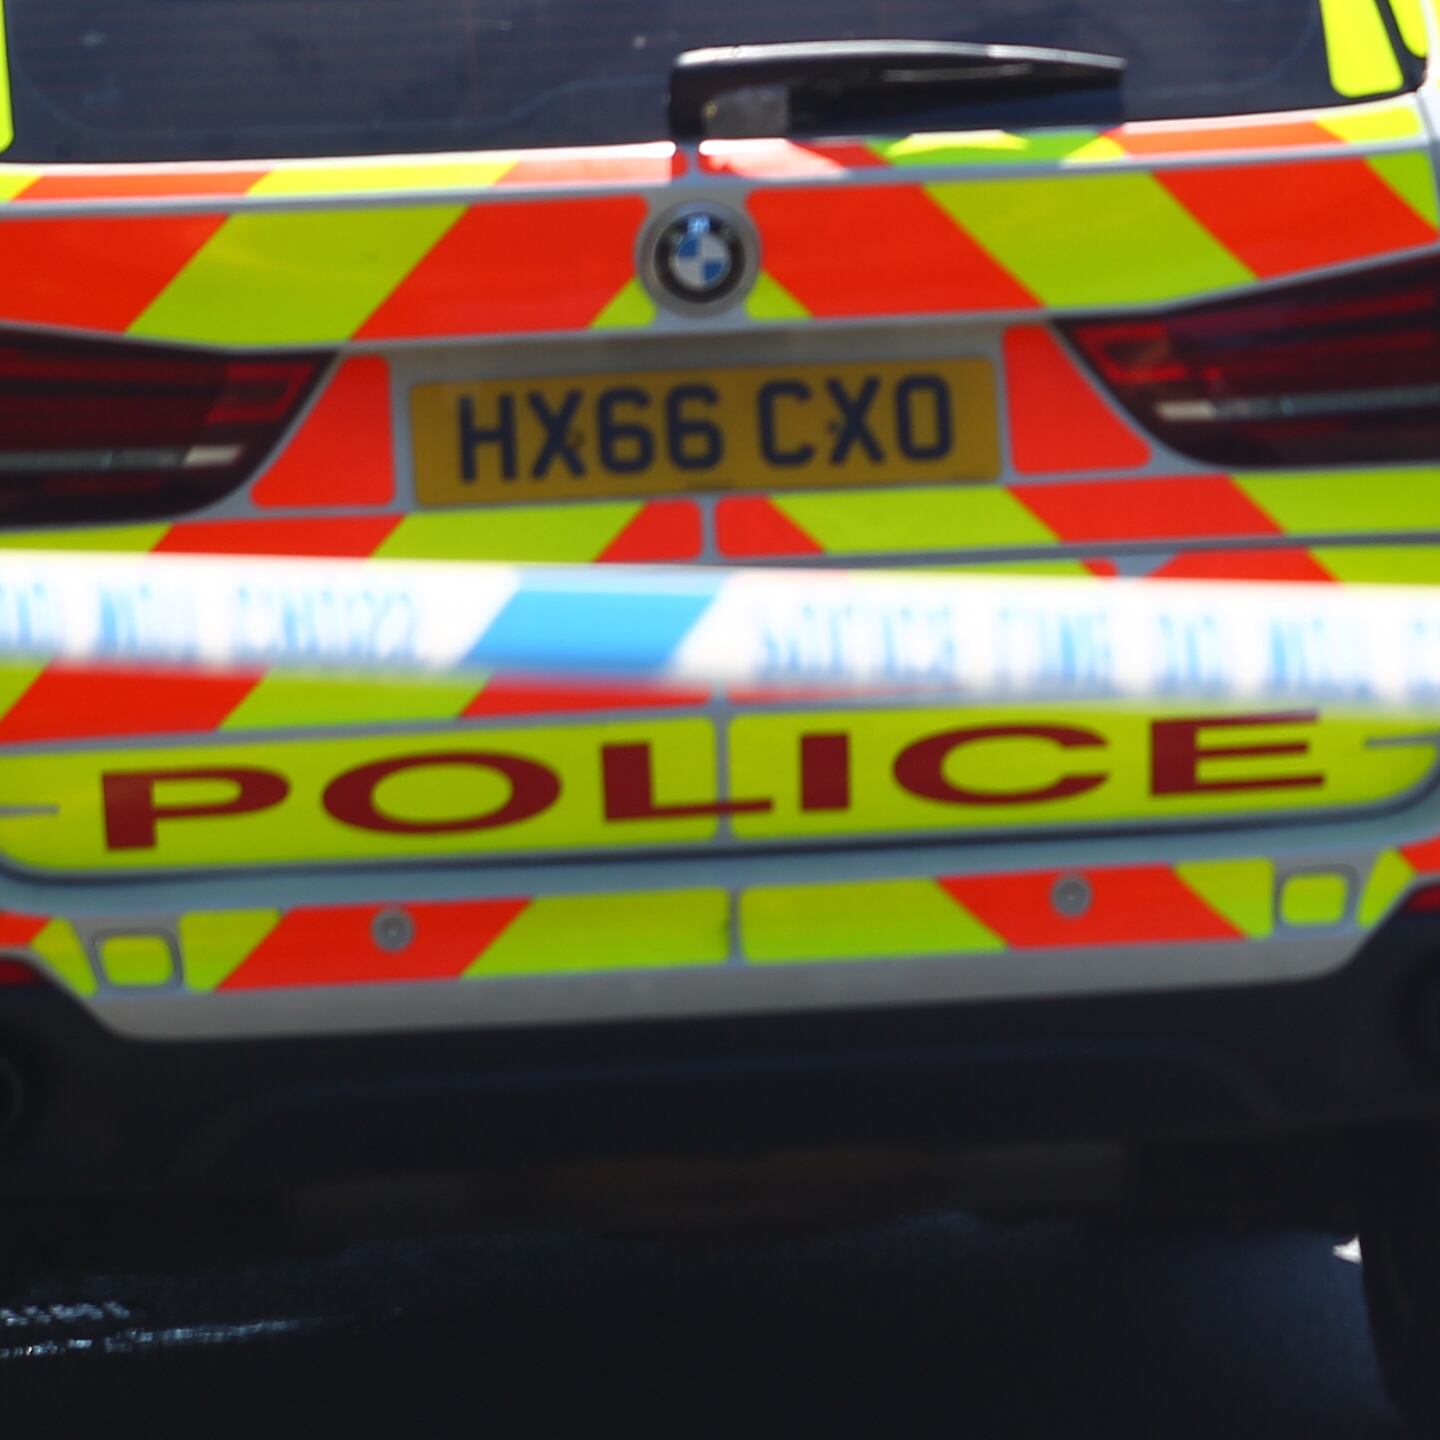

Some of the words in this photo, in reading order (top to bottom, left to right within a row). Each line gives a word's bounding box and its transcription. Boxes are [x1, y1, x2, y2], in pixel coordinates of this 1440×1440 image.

[457, 382, 725, 483] HX66
[757, 373, 953, 467] CXO
[102, 710, 1326, 852] POLICE
